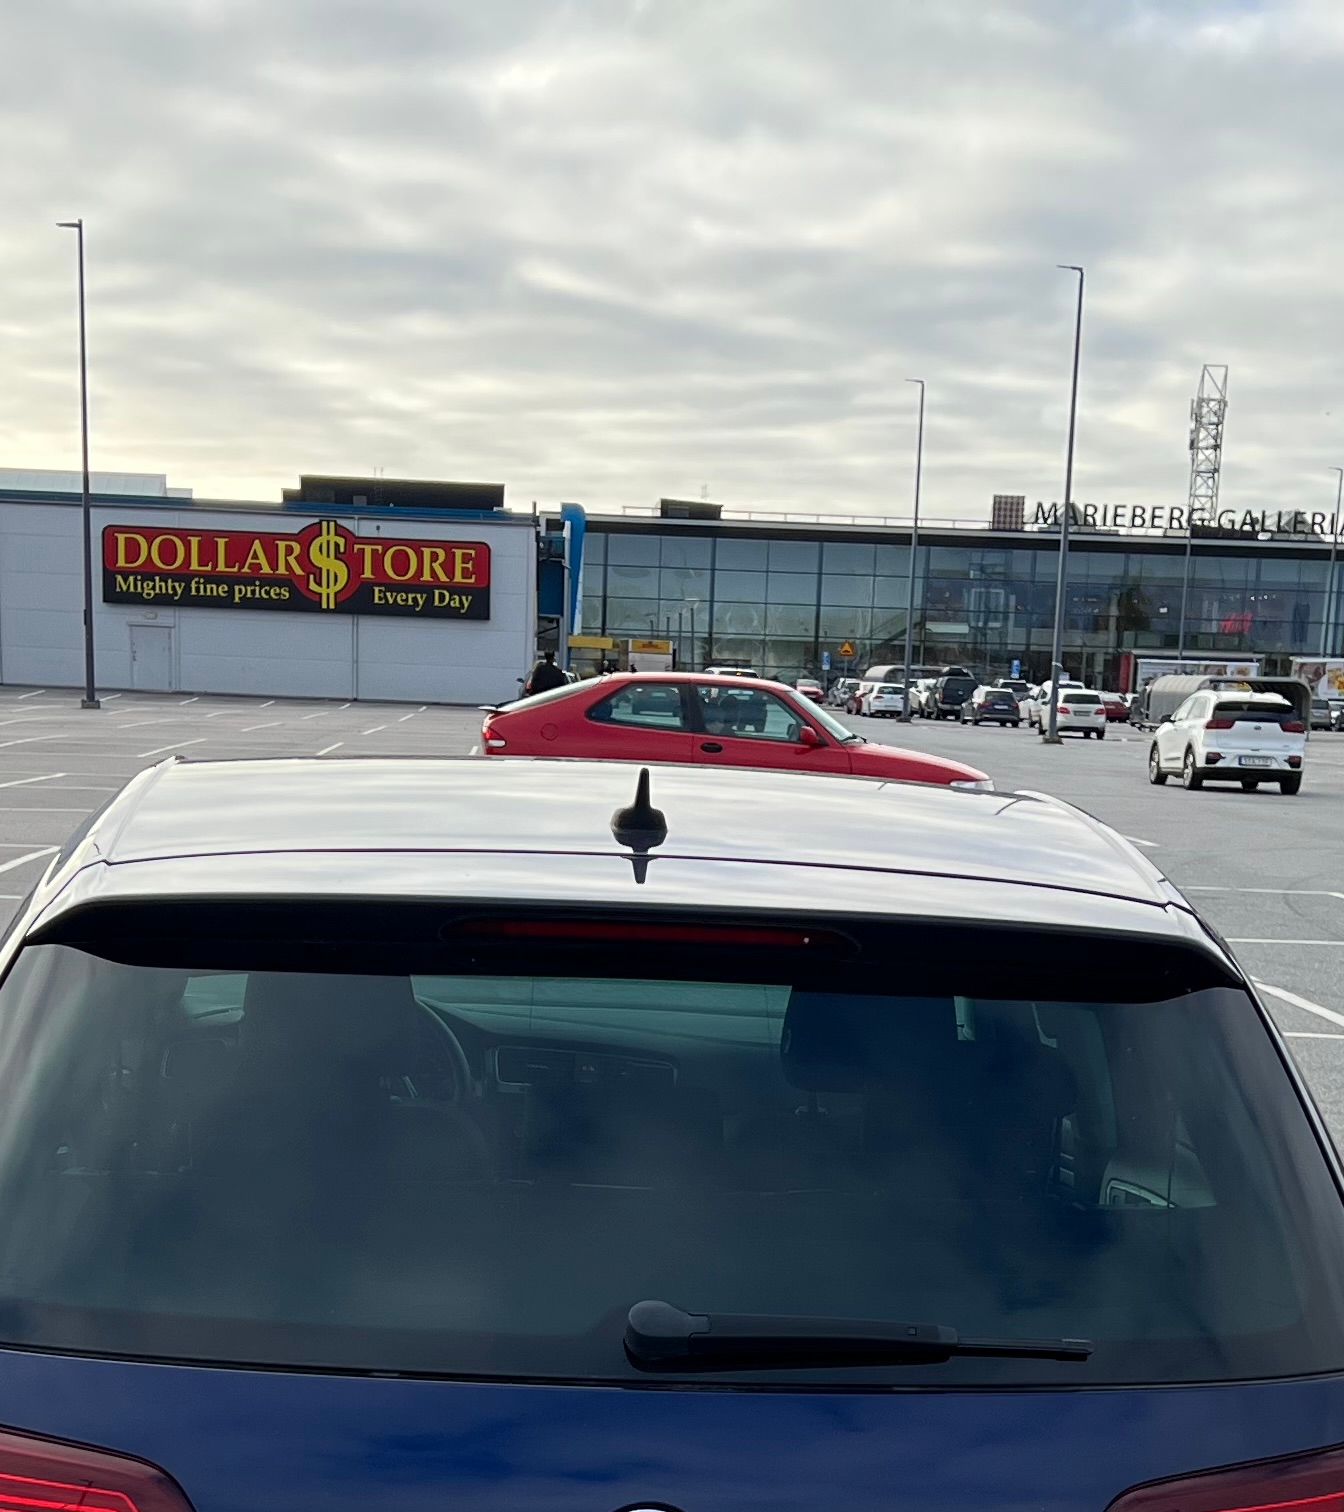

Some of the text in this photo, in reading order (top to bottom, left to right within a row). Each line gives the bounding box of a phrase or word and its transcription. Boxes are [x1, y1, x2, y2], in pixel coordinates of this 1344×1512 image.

[1034, 502, 1207, 530] MARIEBERG
[115, 574, 472, 613] Mighty fine prices Every Day
